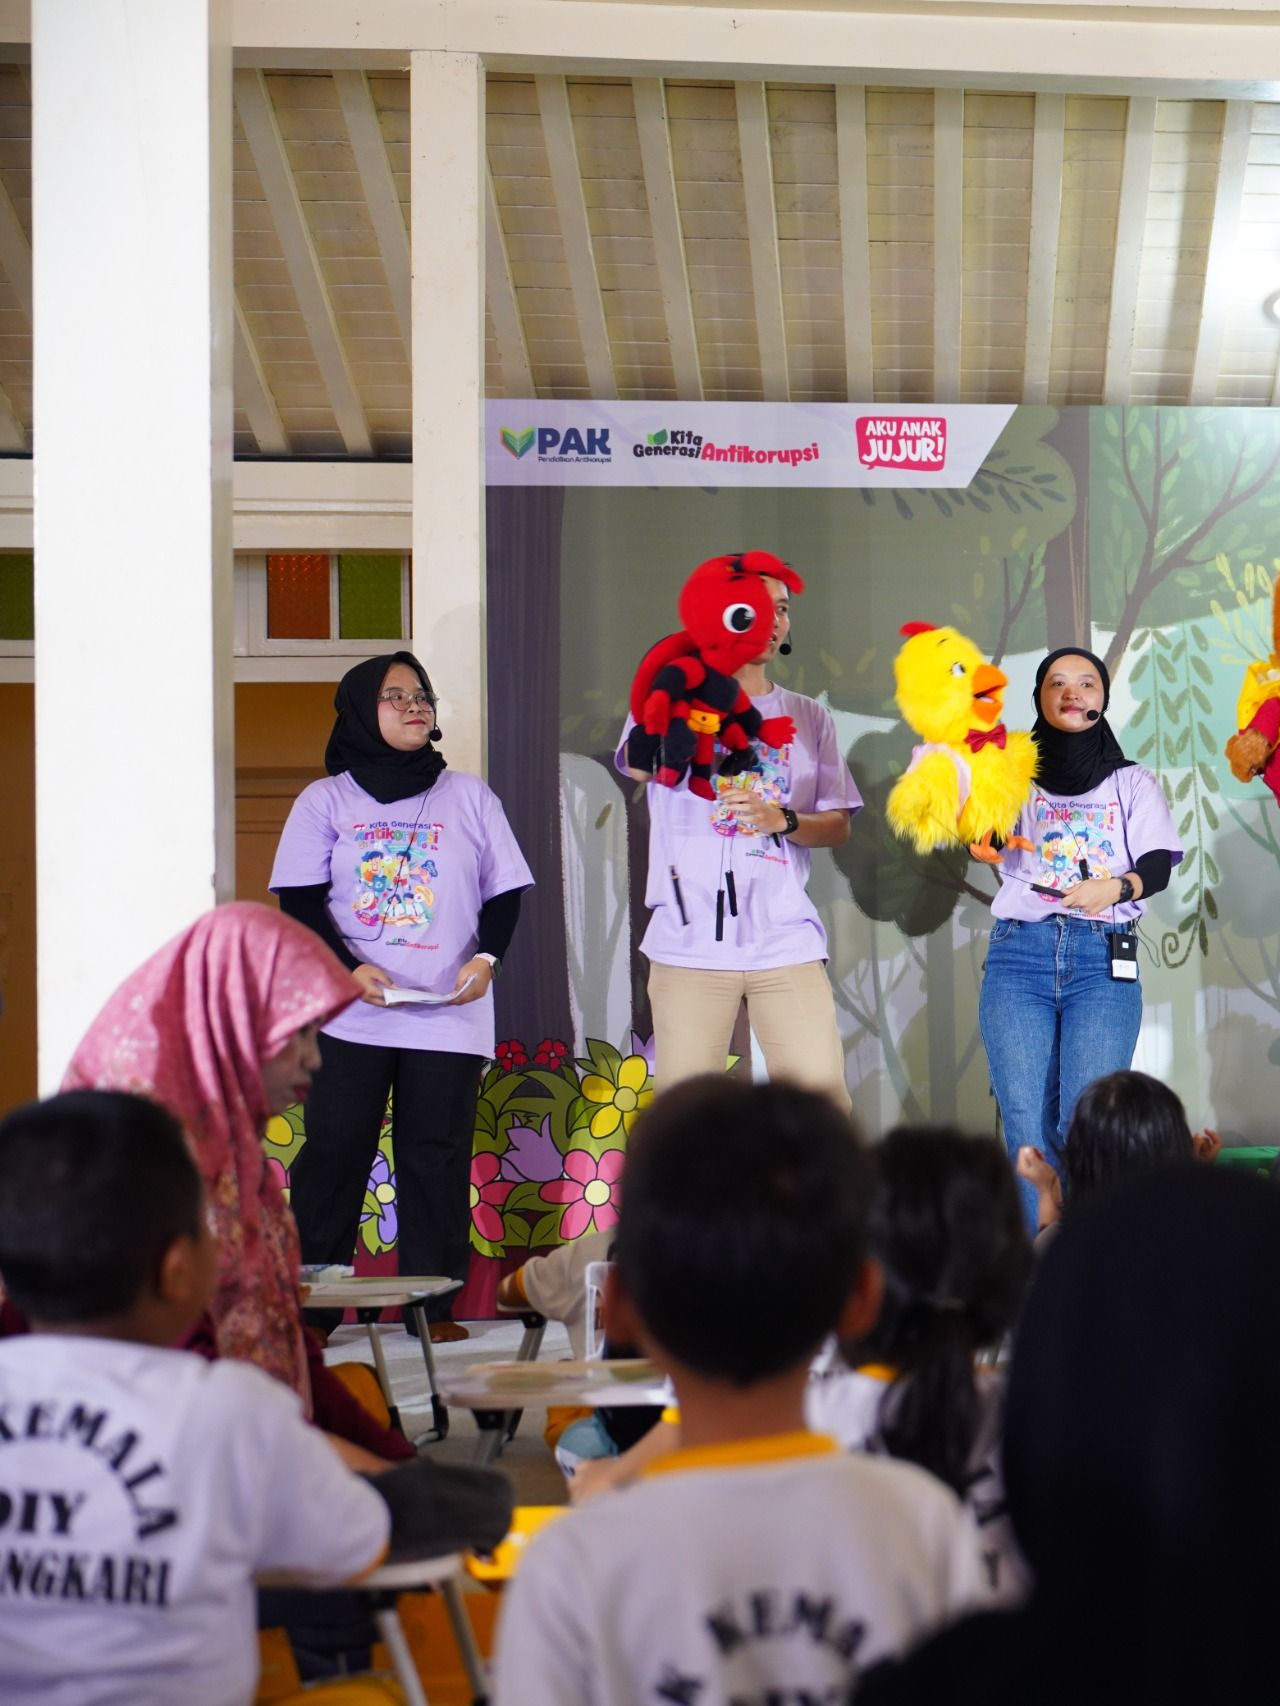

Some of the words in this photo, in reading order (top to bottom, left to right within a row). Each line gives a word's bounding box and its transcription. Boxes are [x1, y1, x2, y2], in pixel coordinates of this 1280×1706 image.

[865, 420, 897, 436] AKU
[900, 420, 942, 436] ANAK
[537, 427, 612, 455] PAK
[670, 430, 703, 446] Kita
[633, 444, 702, 459] Generasi
[701, 442, 820, 467] Antikorupsi
[862, 437, 944, 463] JUJUR!
[1069, 801, 1107, 810] Generasi
[369, 821, 388, 829] Kita
[390, 821, 431, 829] Generasi
